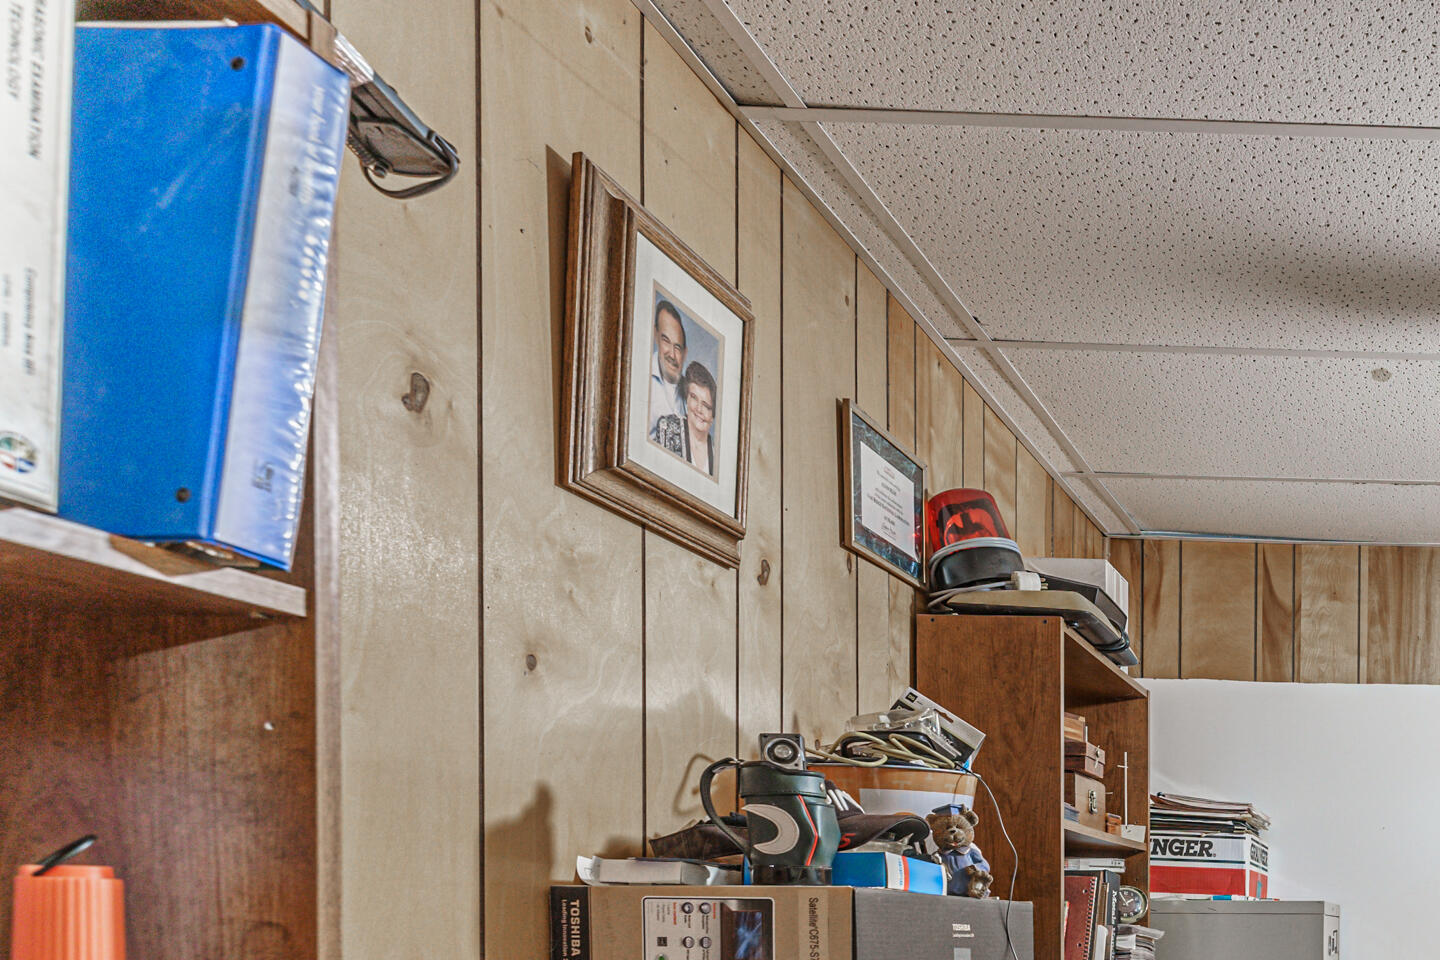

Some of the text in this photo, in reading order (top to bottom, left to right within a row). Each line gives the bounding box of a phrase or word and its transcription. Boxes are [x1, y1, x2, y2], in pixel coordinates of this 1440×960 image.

[1150, 838, 1213, 858] NGER
[570, 899, 581, 957] TOSHIBA
[952, 923, 971, 931] TOSHIBA
[561, 924, 569, 957] Innovation
